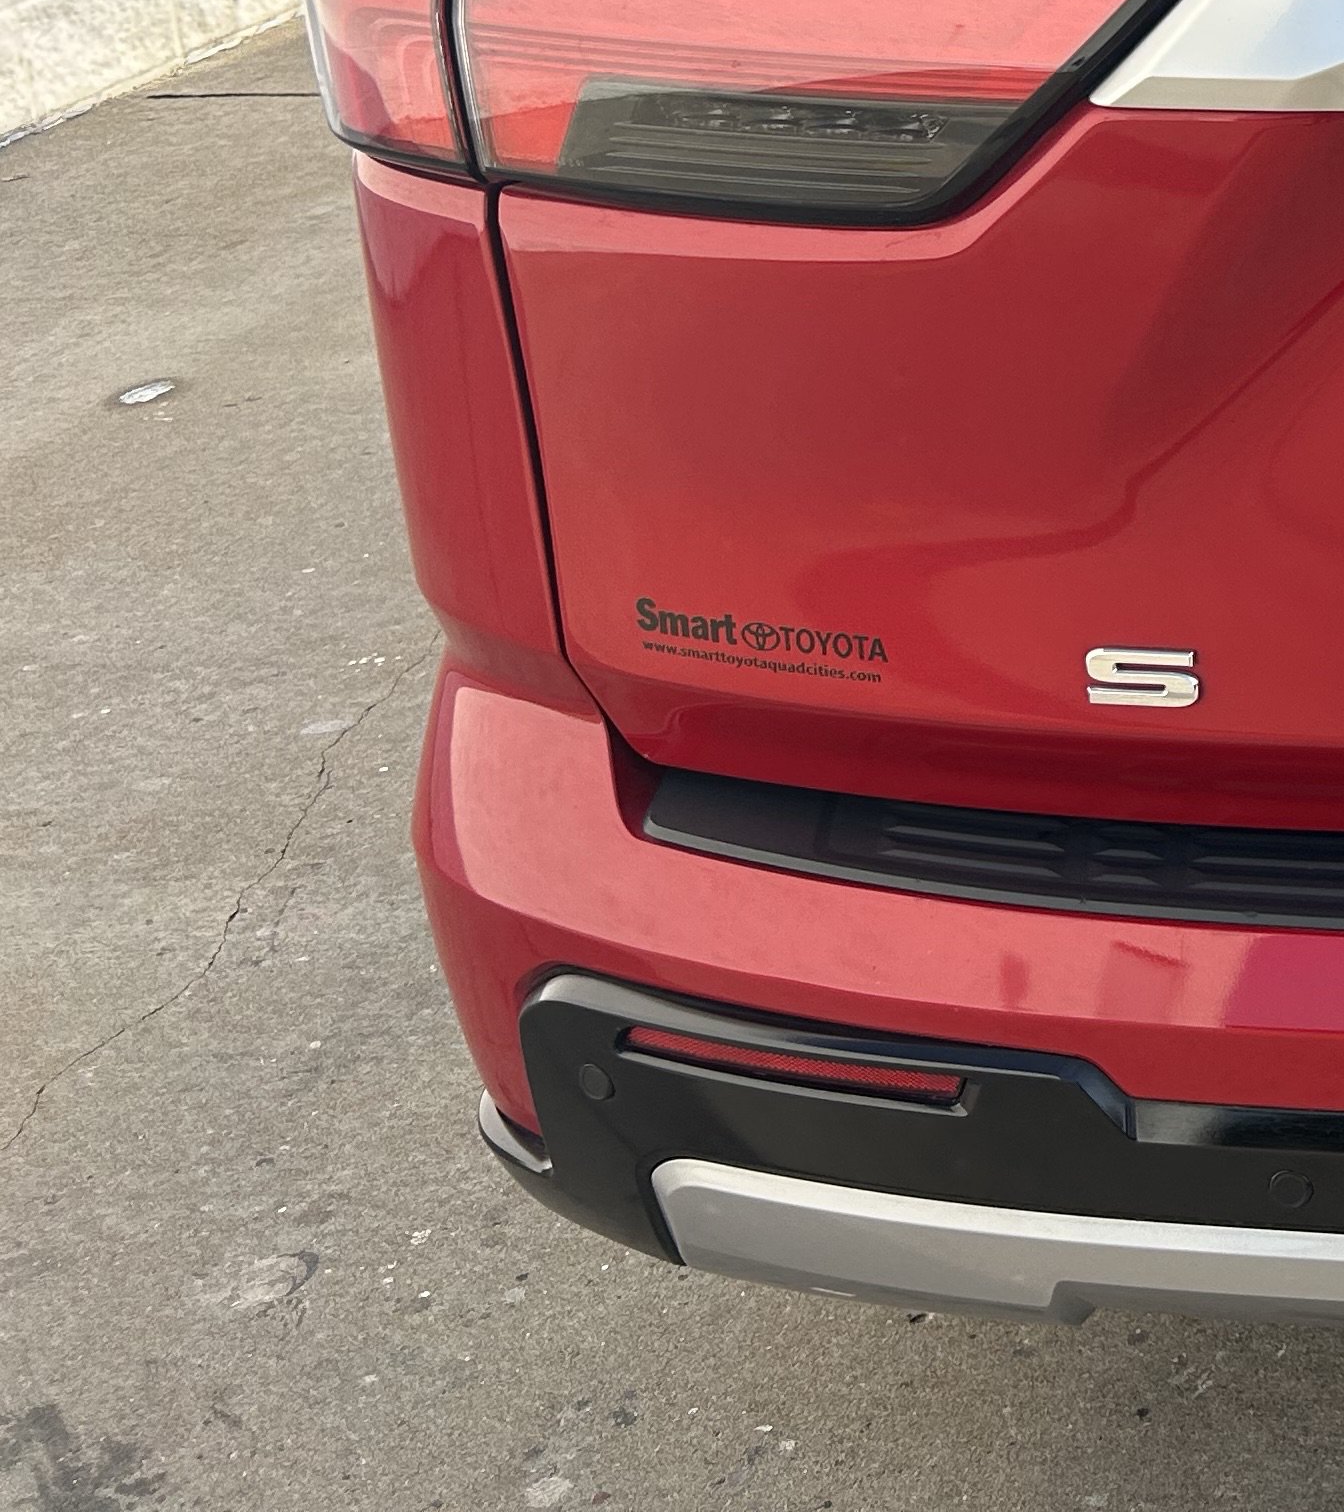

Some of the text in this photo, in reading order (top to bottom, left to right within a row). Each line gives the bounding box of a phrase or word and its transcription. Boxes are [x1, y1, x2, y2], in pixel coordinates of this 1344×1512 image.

[636, 597, 889, 663] Smart TOYOTA
[642, 640, 882, 683] www.smarttoyotaquadcities.com
